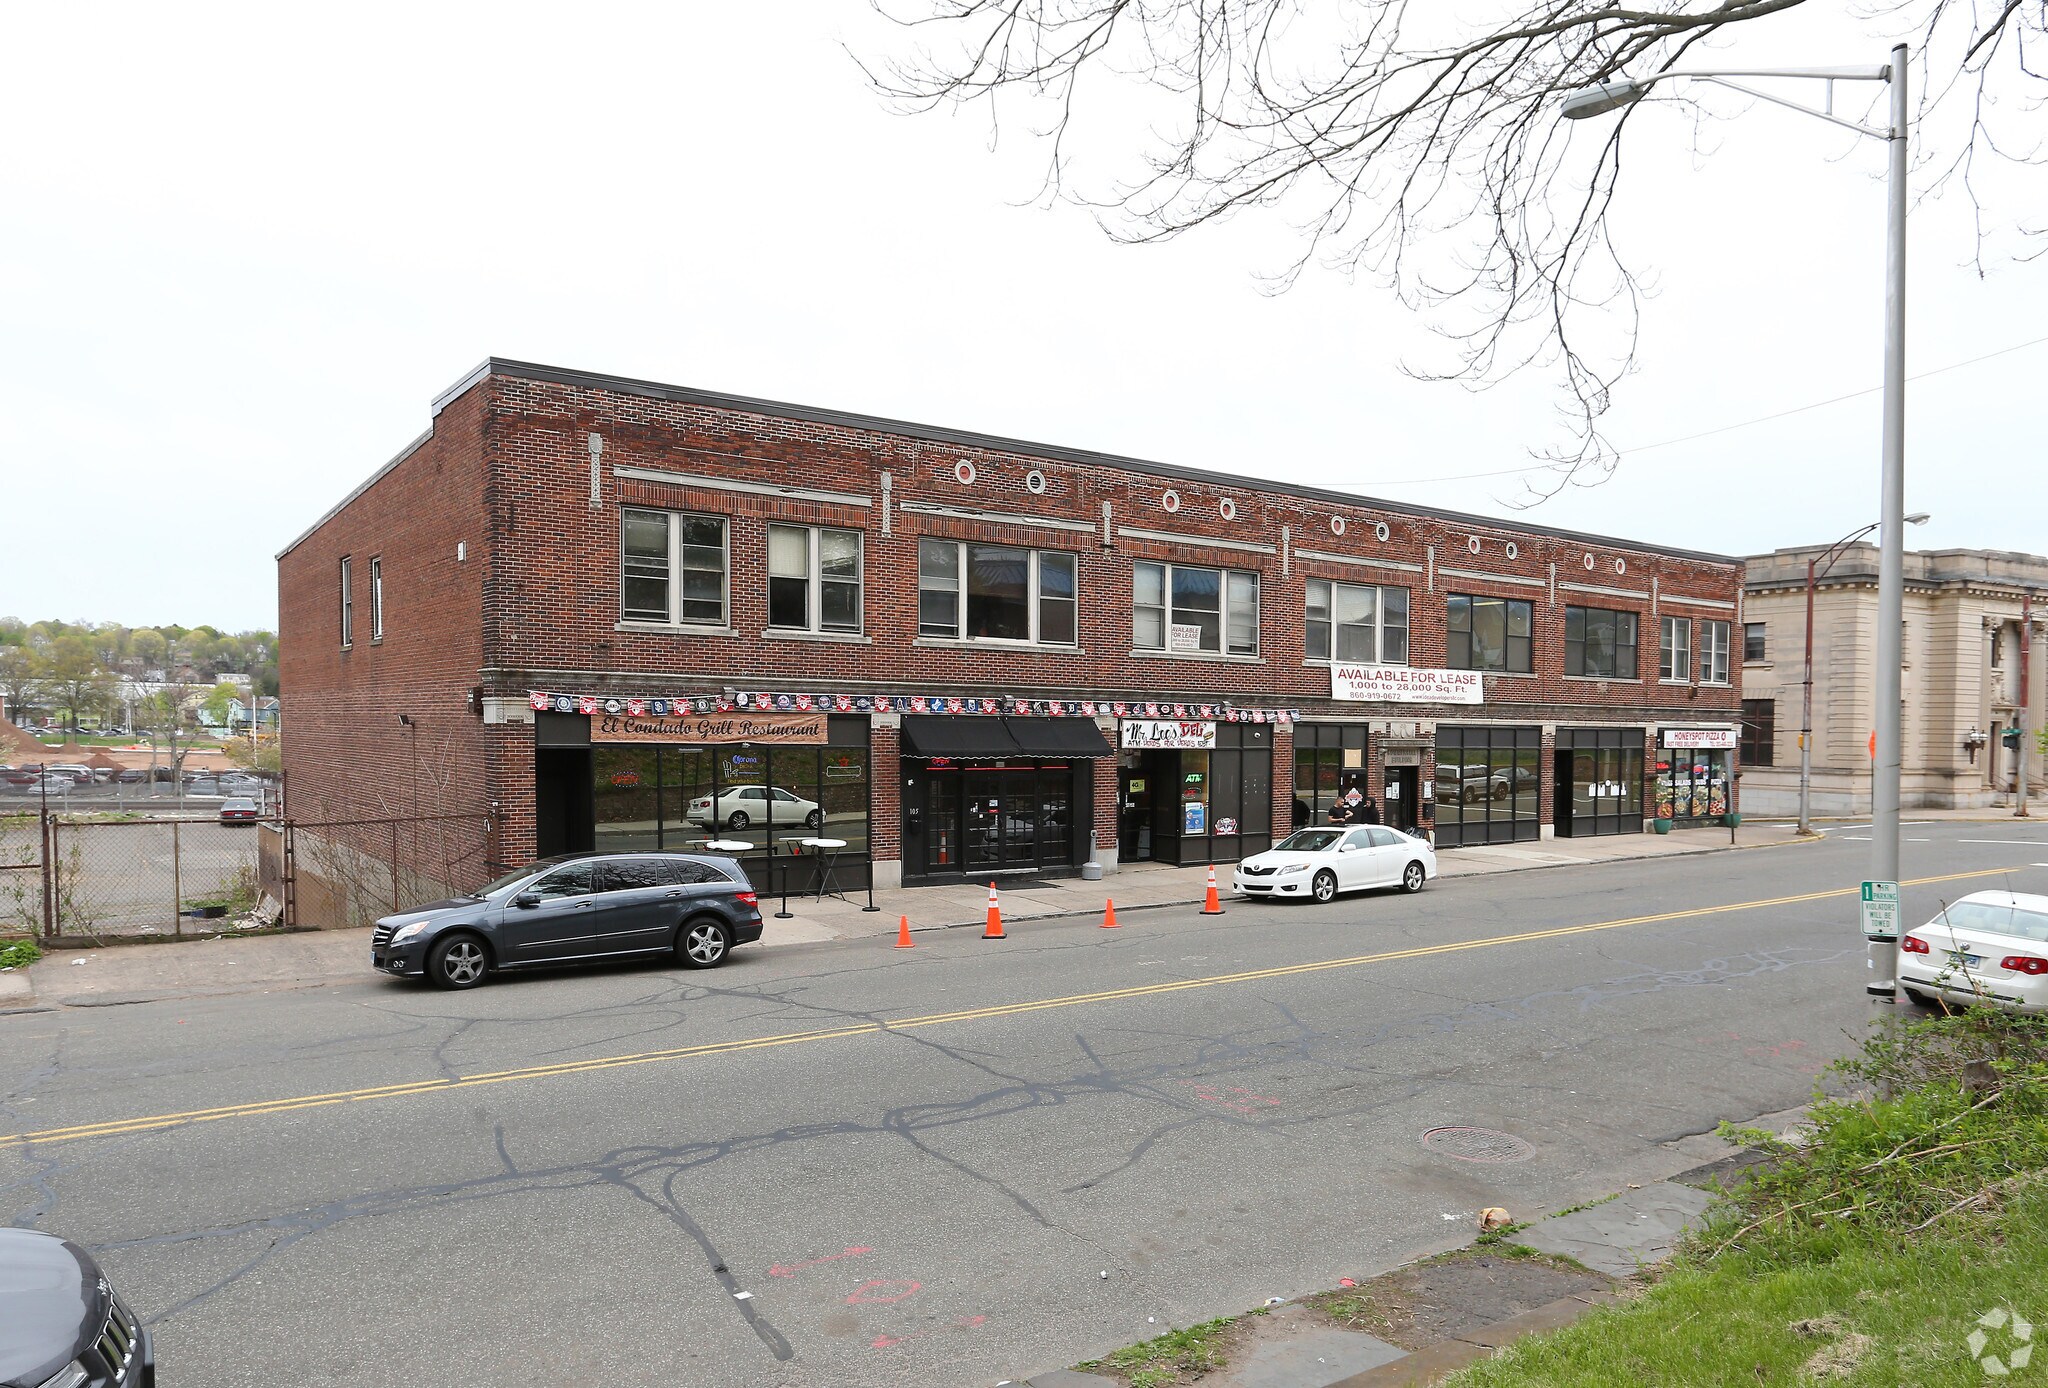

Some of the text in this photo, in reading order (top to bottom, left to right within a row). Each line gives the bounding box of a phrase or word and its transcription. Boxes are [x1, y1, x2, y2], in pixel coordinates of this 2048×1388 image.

[1338, 669, 1477, 685] AVAILABLE FOR LEASE
[1349, 681, 1378, 690] 1,000
[1396, 683, 1432, 692] 28,000
[1435, 685, 1452, 694] Sq.
[1455, 685, 1468, 693] Ft.
[1349, 691, 1401, 700] 860-919-0672
[600, 717, 820, 739] El Condado Grill Restaurant
[1674, 732, 1719, 740] HONEYSPOT PIZZA
[732, 754, 757, 764] Corona
[931, 757, 950, 765] OPEN
[1865, 886, 1869, 900] 1
[1873, 892, 1897, 900] PARKING
[1865, 903, 1895, 912] VIOLATORS
[1869, 911, 1892, 919] WILL BE
[1871, 919, 1890, 928] TOWED
